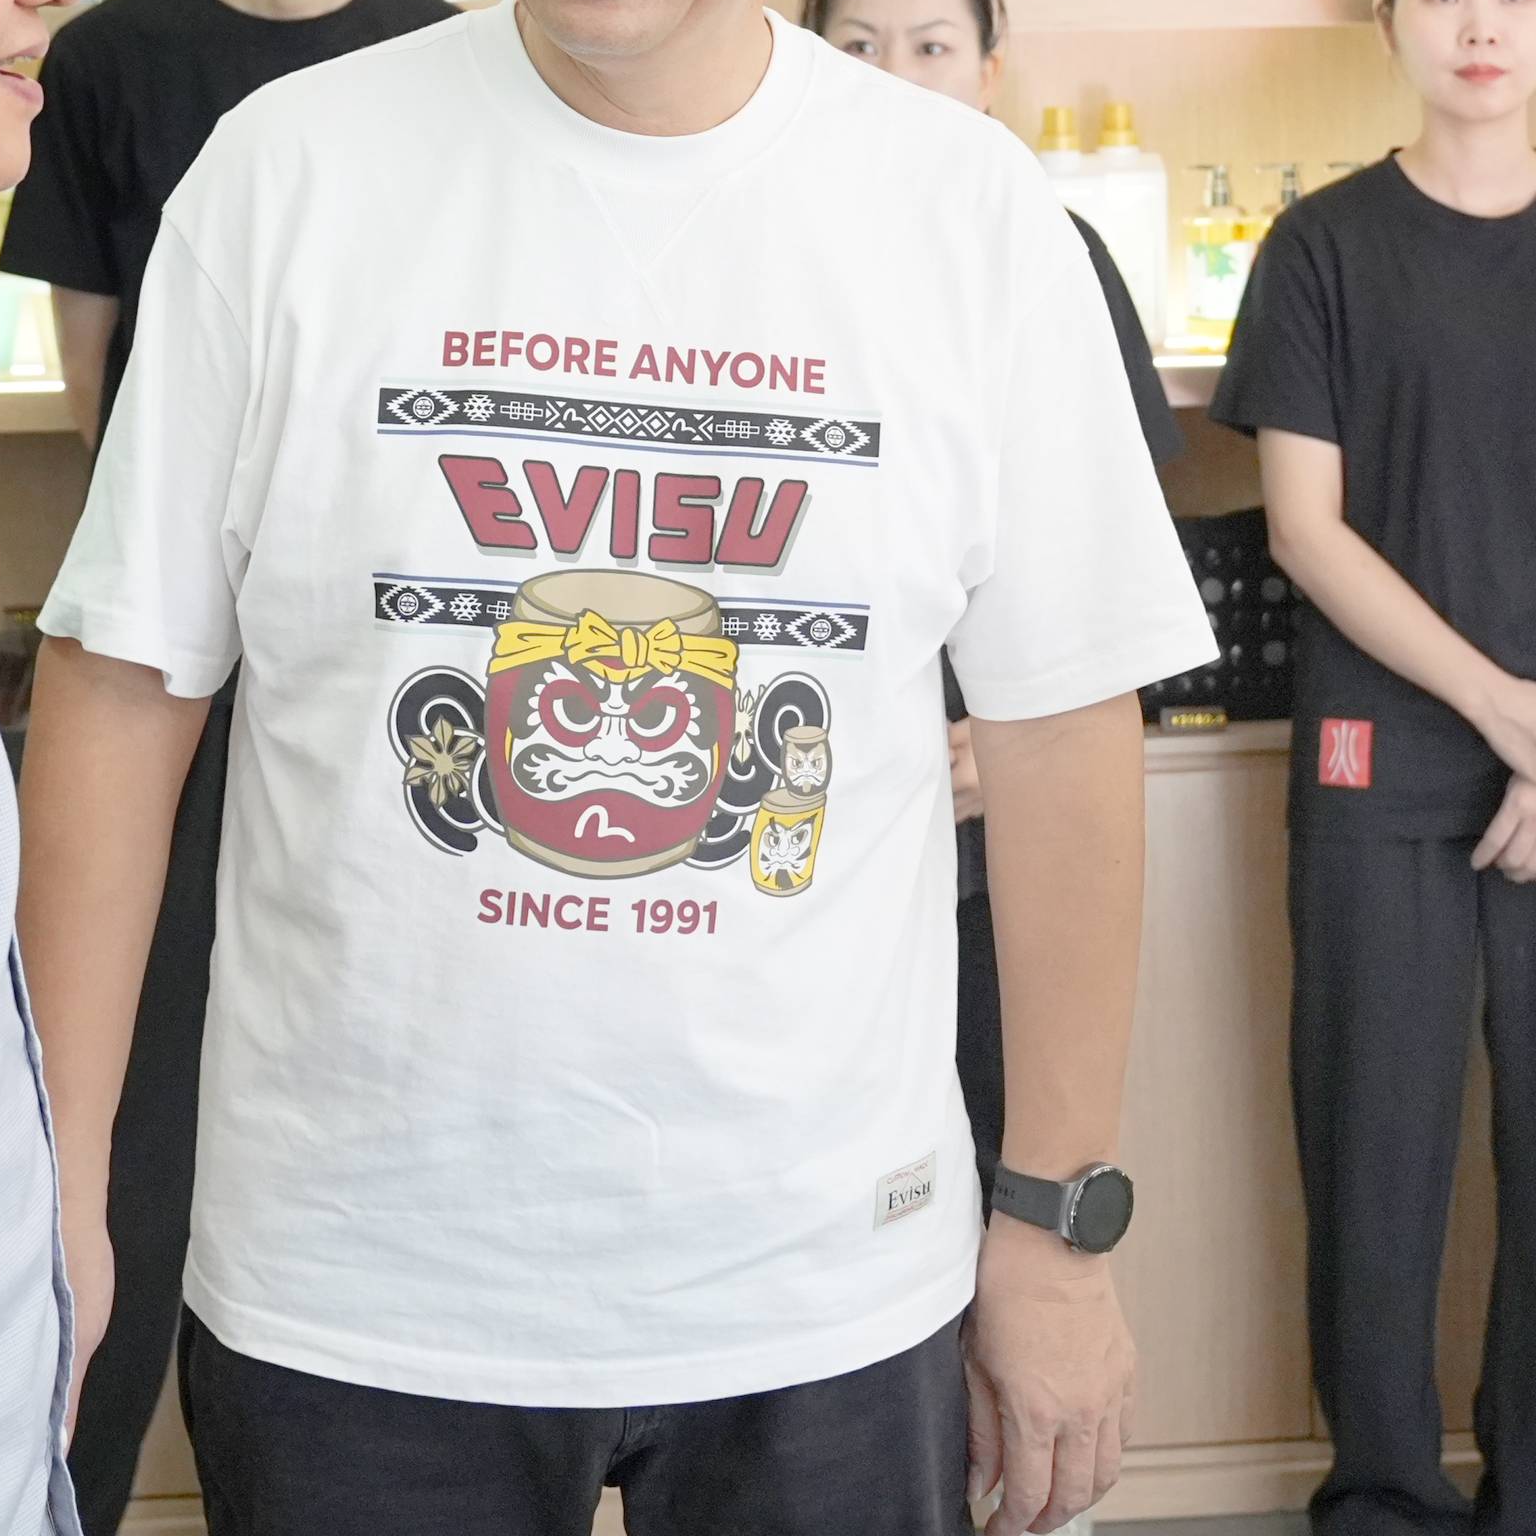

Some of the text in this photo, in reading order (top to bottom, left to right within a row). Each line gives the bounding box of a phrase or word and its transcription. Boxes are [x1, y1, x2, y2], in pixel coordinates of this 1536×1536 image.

[442, 330, 827, 394] BEFORE ANYONE
[437, 453, 812, 570] EVISU
[477, 888, 718, 935] SINCE 1991
[887, 1180, 931, 1211] Evisu
